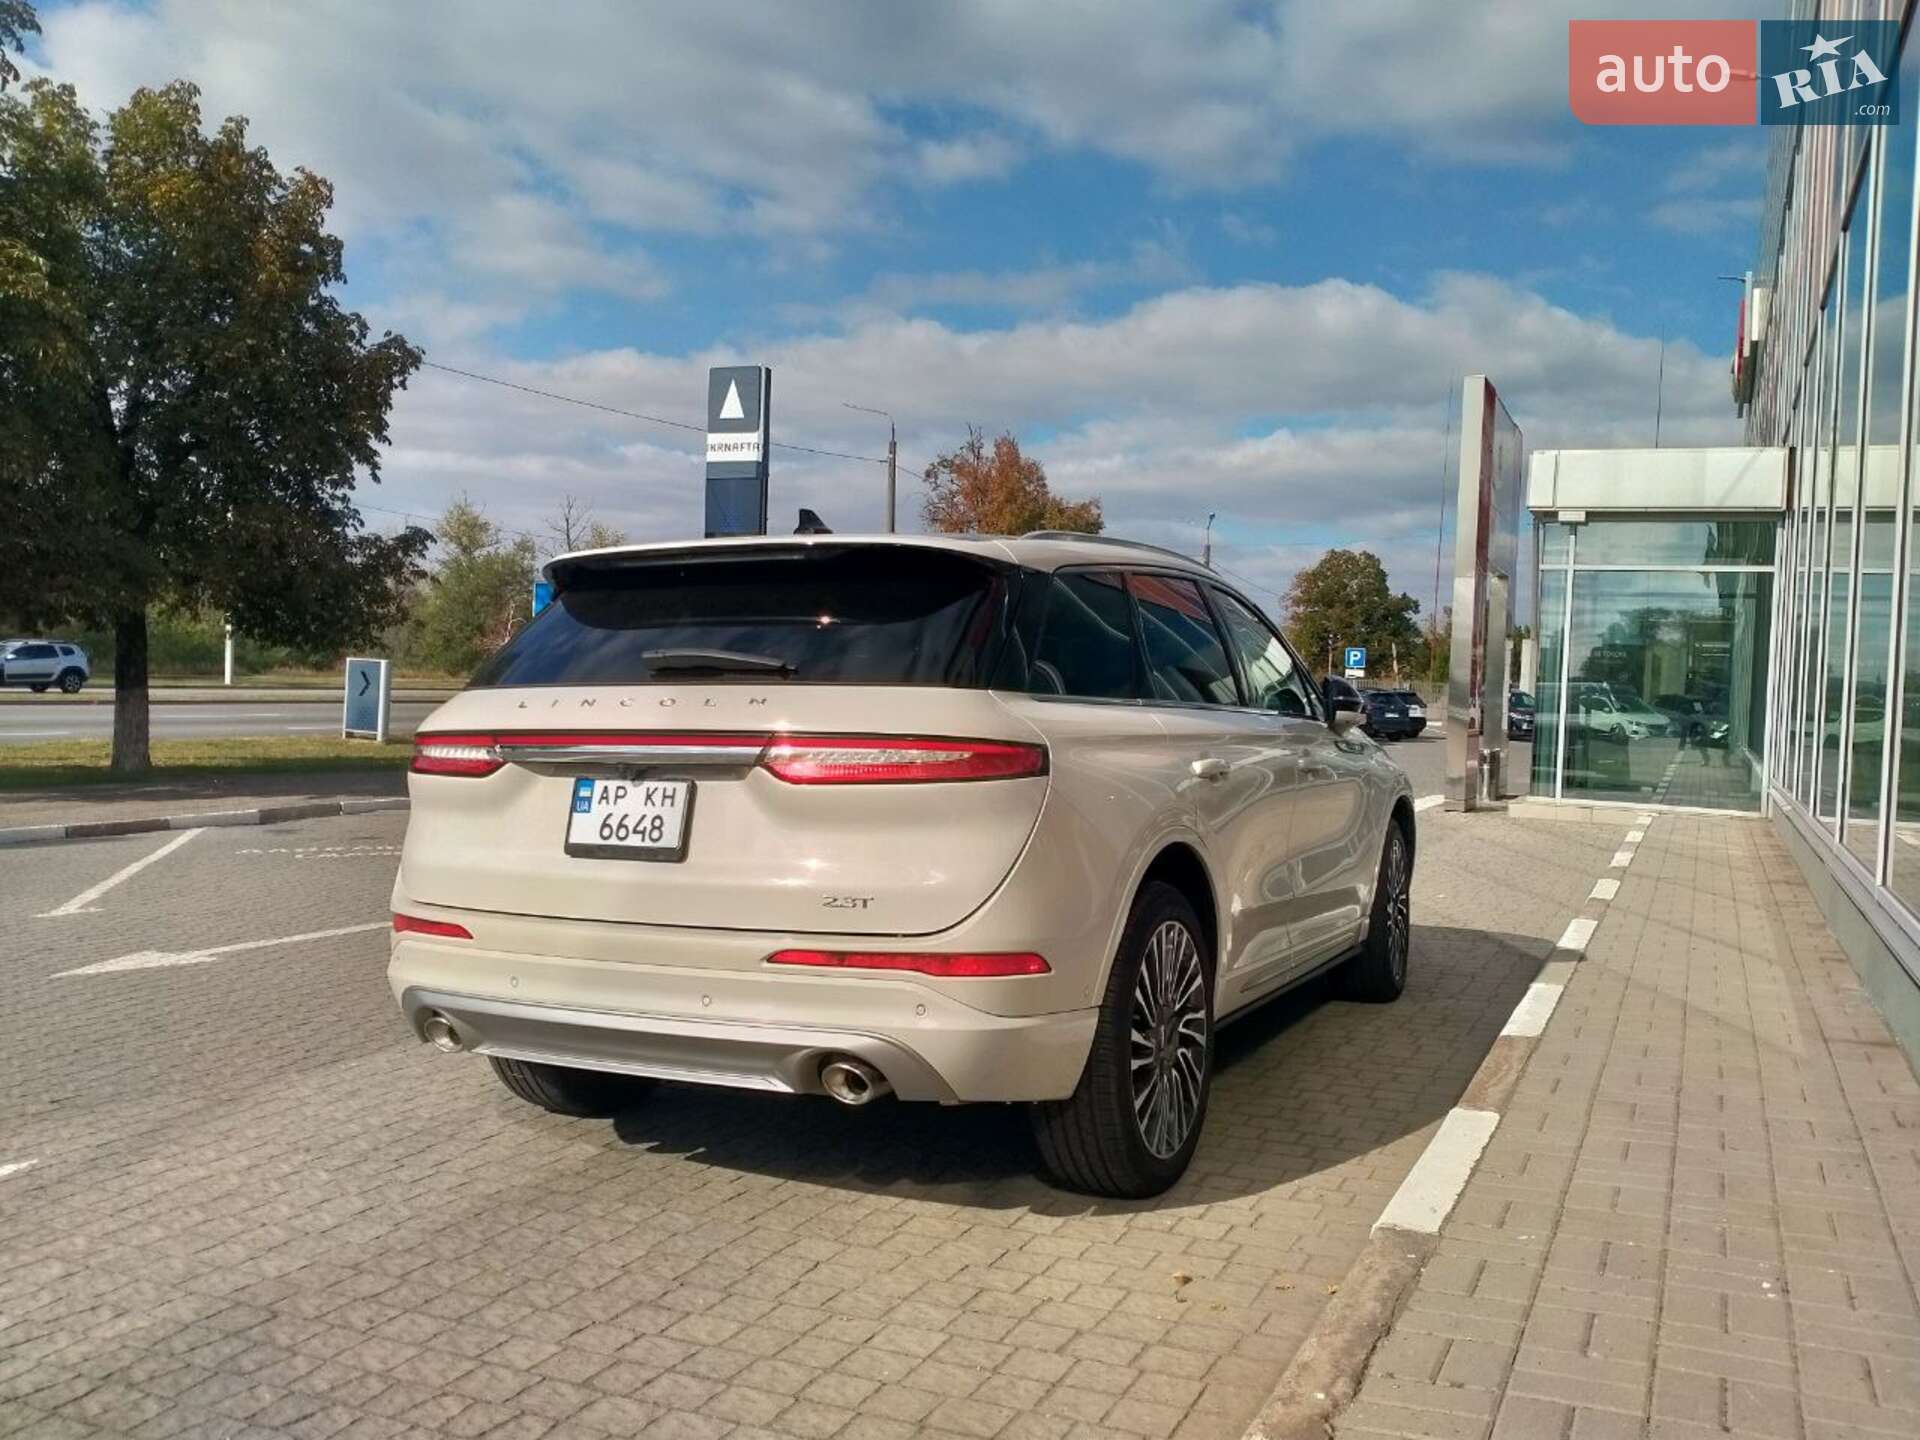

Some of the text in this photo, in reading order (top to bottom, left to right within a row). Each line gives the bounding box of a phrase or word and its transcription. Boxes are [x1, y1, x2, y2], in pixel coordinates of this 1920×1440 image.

[1349, 650, 1361, 666] P
[518, 697, 768, 709] LINCOLN
[598, 785, 676, 807] AP KH
[576, 800, 590, 812] UA
[600, 813, 664, 843] 6648
